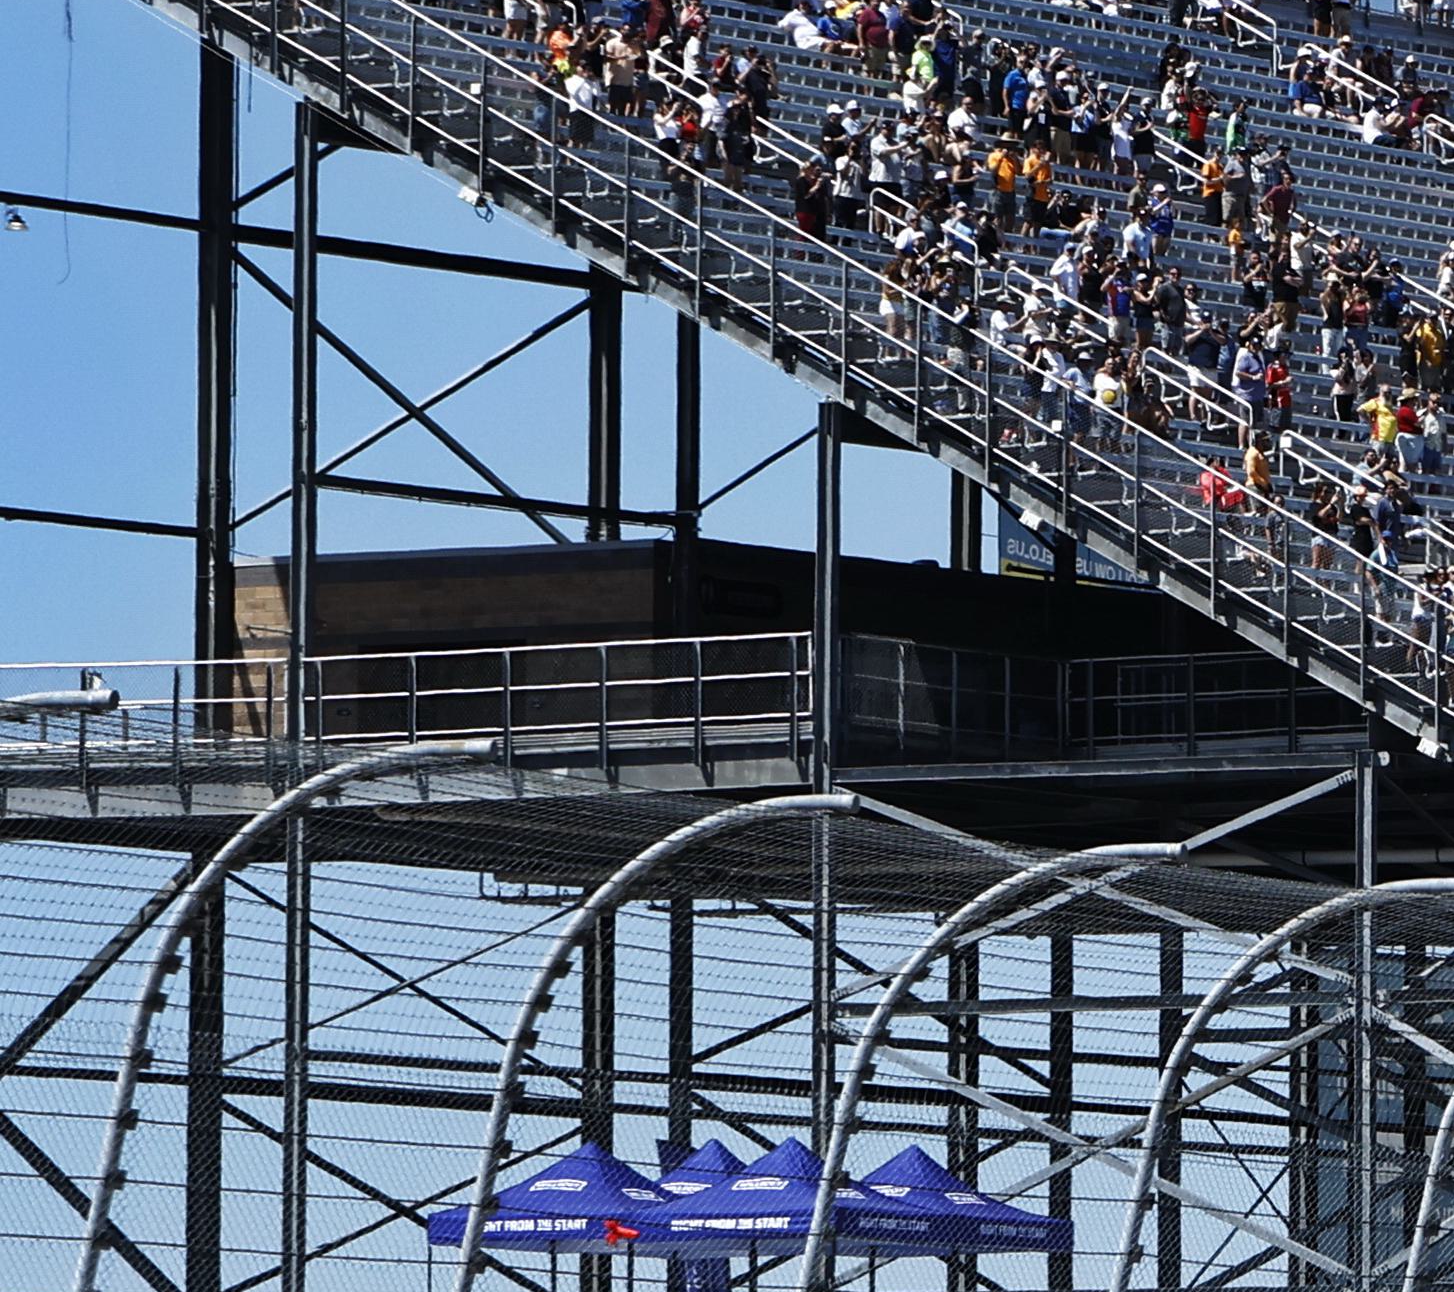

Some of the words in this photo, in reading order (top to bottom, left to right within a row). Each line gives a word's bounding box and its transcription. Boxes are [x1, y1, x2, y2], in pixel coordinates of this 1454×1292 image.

[504, 1219, 534, 1232] FROM
[554, 1218, 587, 1231] START
[754, 1217, 791, 1229] START
